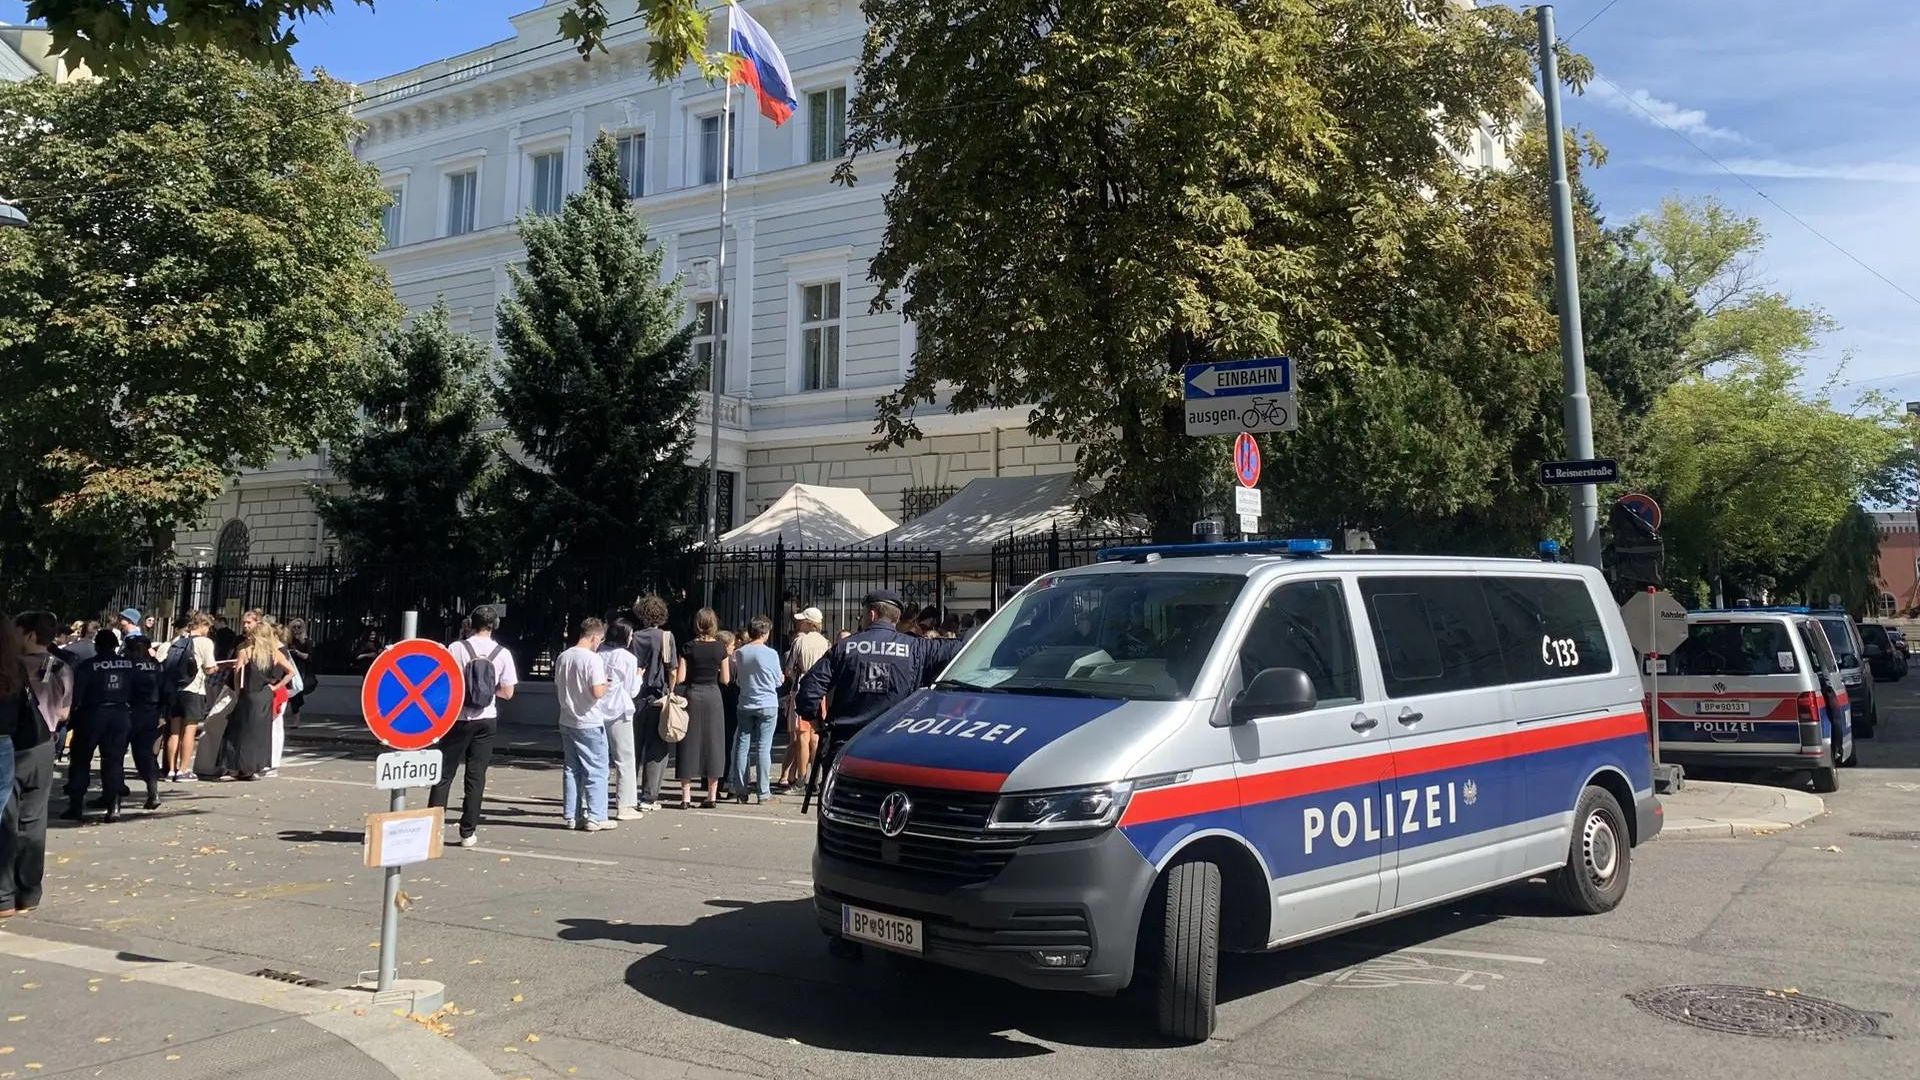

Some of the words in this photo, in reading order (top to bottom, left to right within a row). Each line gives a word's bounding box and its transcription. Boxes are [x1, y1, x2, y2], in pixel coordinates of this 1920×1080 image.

[1217, 368, 1277, 387] EINBAHN
[1189, 409, 1241, 425] ausgen.
[1556, 466, 1613, 478] Reisnerstraße
[845, 640, 910, 658] POLIZEI
[1551, 638, 1579, 667] 133
[93, 660, 132, 671] POLIZEI
[886, 718, 1028, 745] POLIZEI
[1693, 721, 1755, 732] POLIZEI
[381, 760, 438, 781] Anfang
[1303, 782, 1457, 855] POLIZEI
[877, 918, 913, 945] 91158
